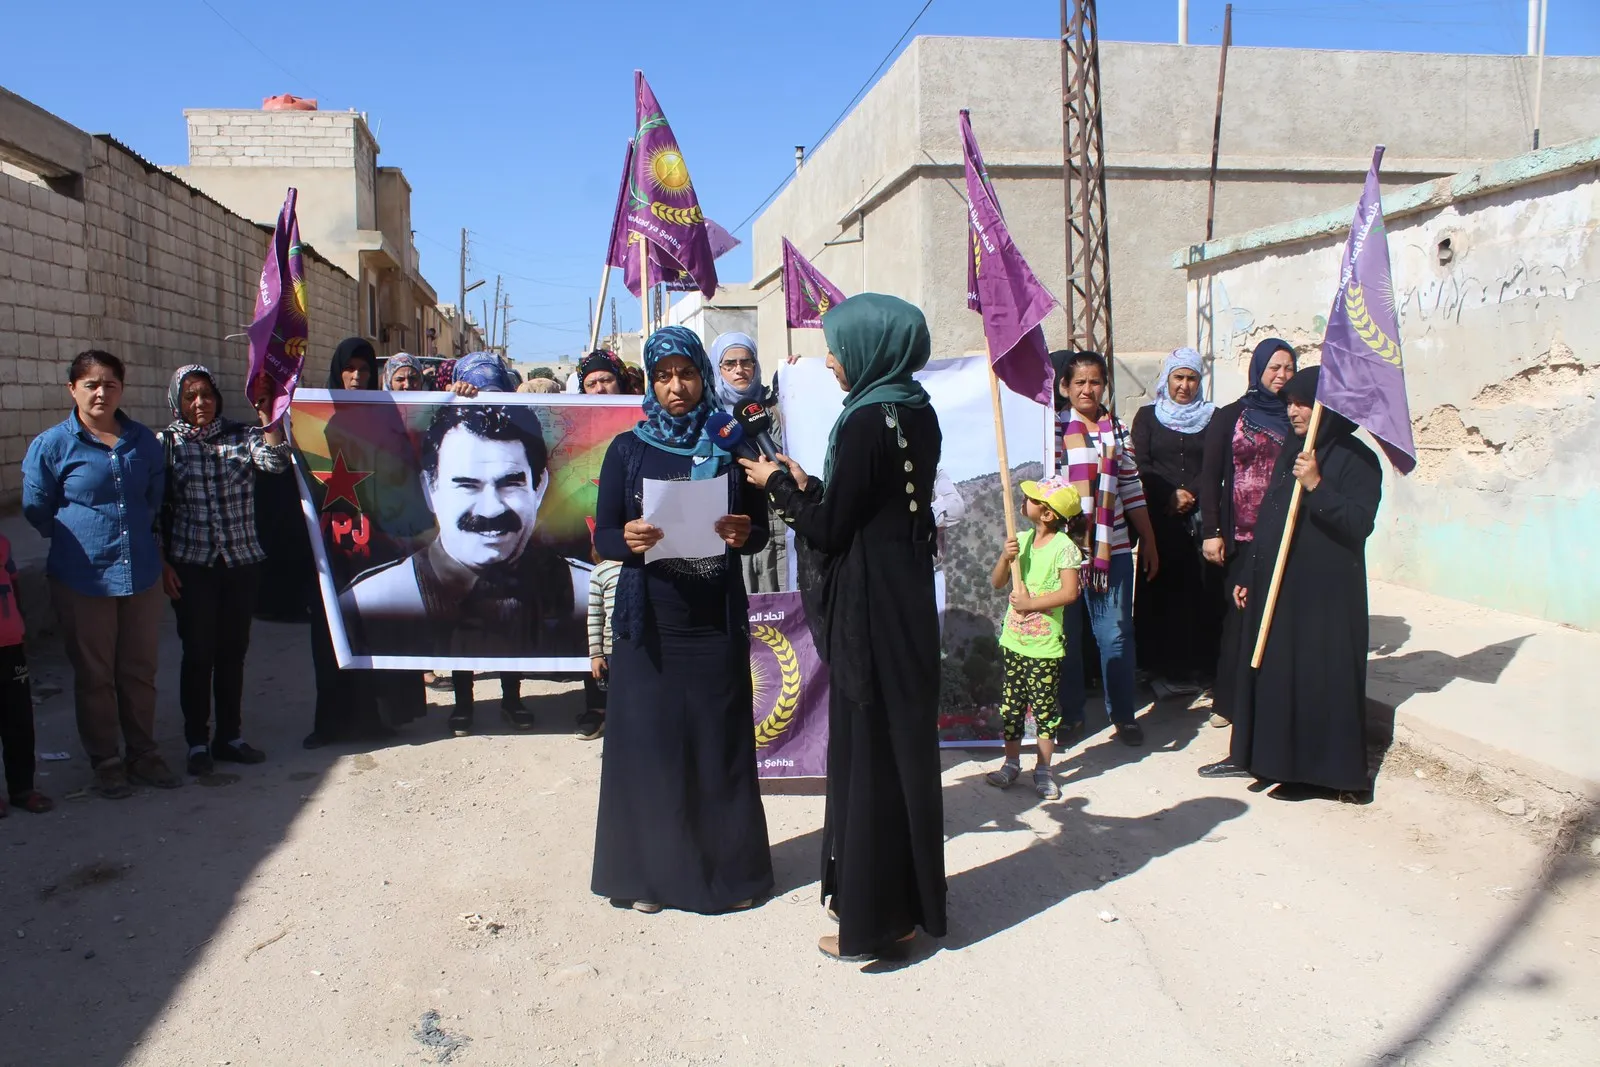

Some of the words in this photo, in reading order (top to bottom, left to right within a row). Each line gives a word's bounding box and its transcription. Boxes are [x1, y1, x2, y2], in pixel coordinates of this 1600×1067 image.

[648, 224, 659, 233] ya
[265, 352, 281, 368] zad
[763, 611, 785, 622] اتحاد
[764, 758, 794, 769] Şehba
